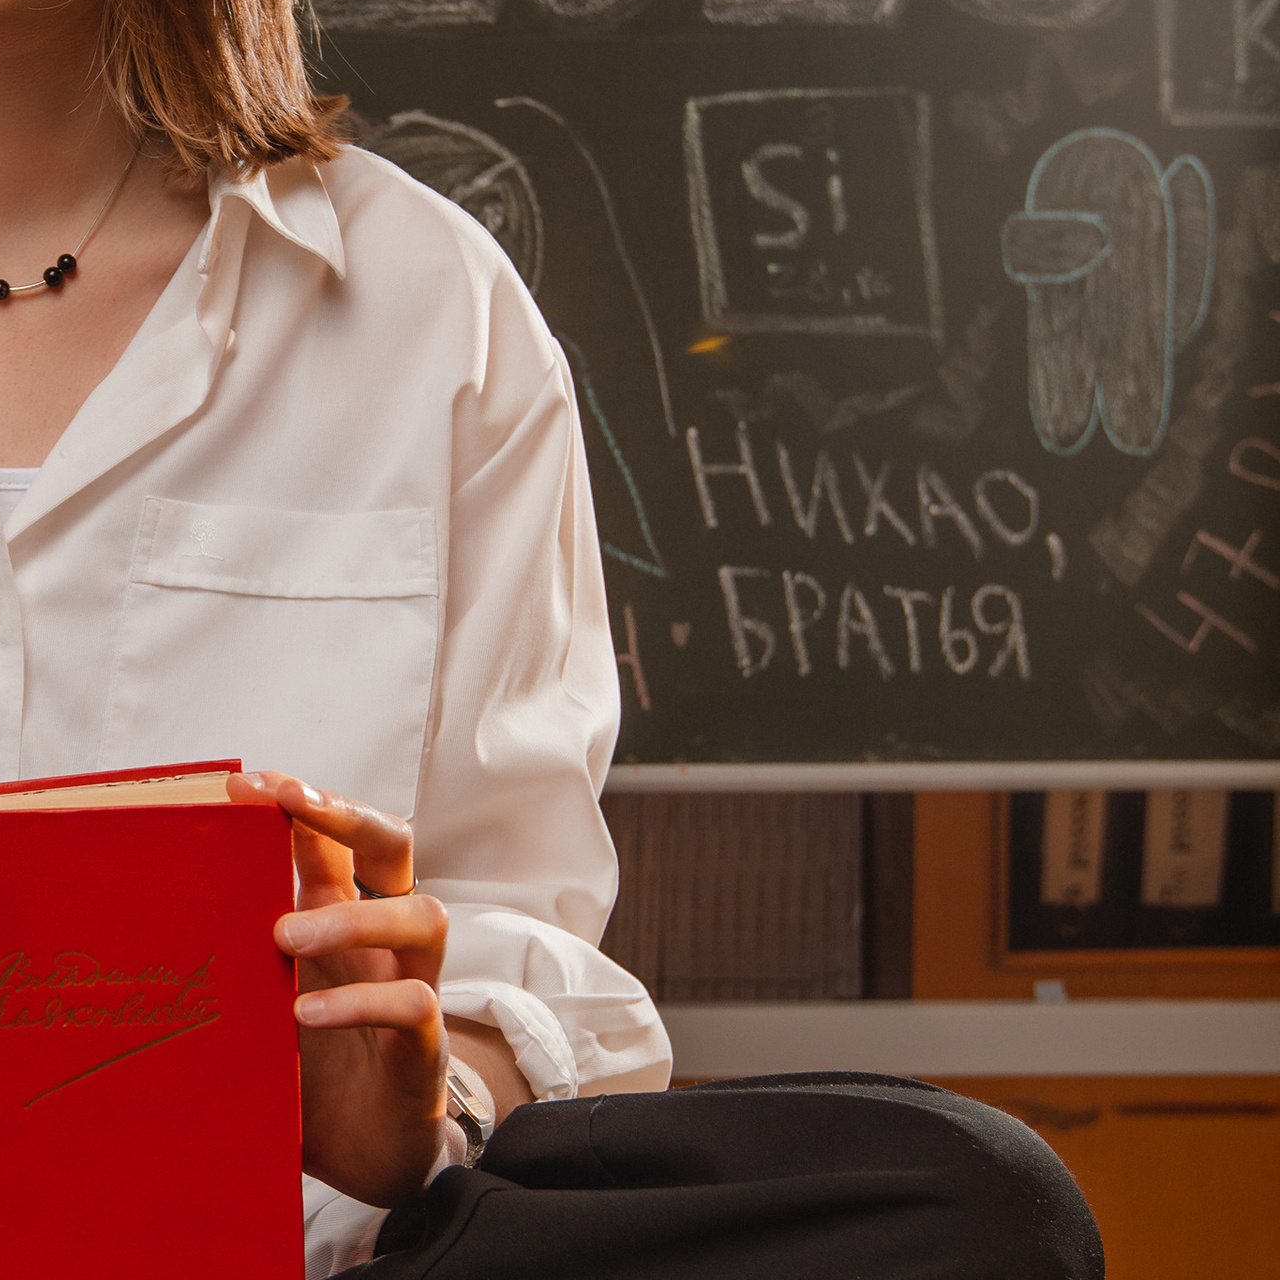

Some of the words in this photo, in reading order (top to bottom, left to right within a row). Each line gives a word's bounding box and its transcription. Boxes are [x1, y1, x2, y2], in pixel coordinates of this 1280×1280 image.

[741, 142, 849, 250] Si
[685, 419, 1068, 580] НИХАО,
[718, 564, 1033, 680] БРАТЬЯ
